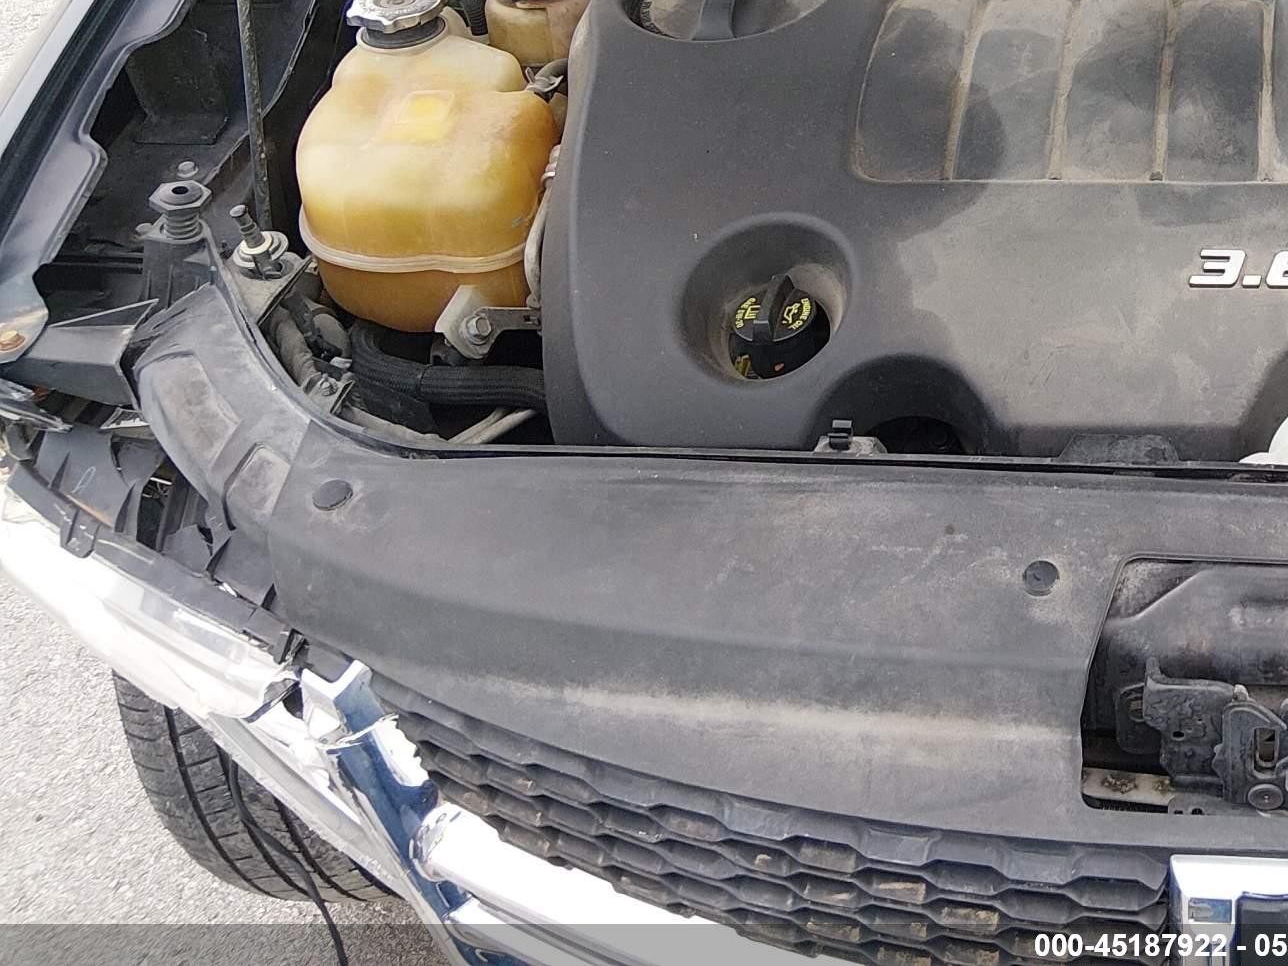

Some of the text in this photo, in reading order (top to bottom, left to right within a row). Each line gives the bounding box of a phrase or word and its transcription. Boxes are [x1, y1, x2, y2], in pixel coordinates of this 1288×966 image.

[740, 297, 756, 309] SAE
[788, 297, 811, 330] ENGINE OIL
